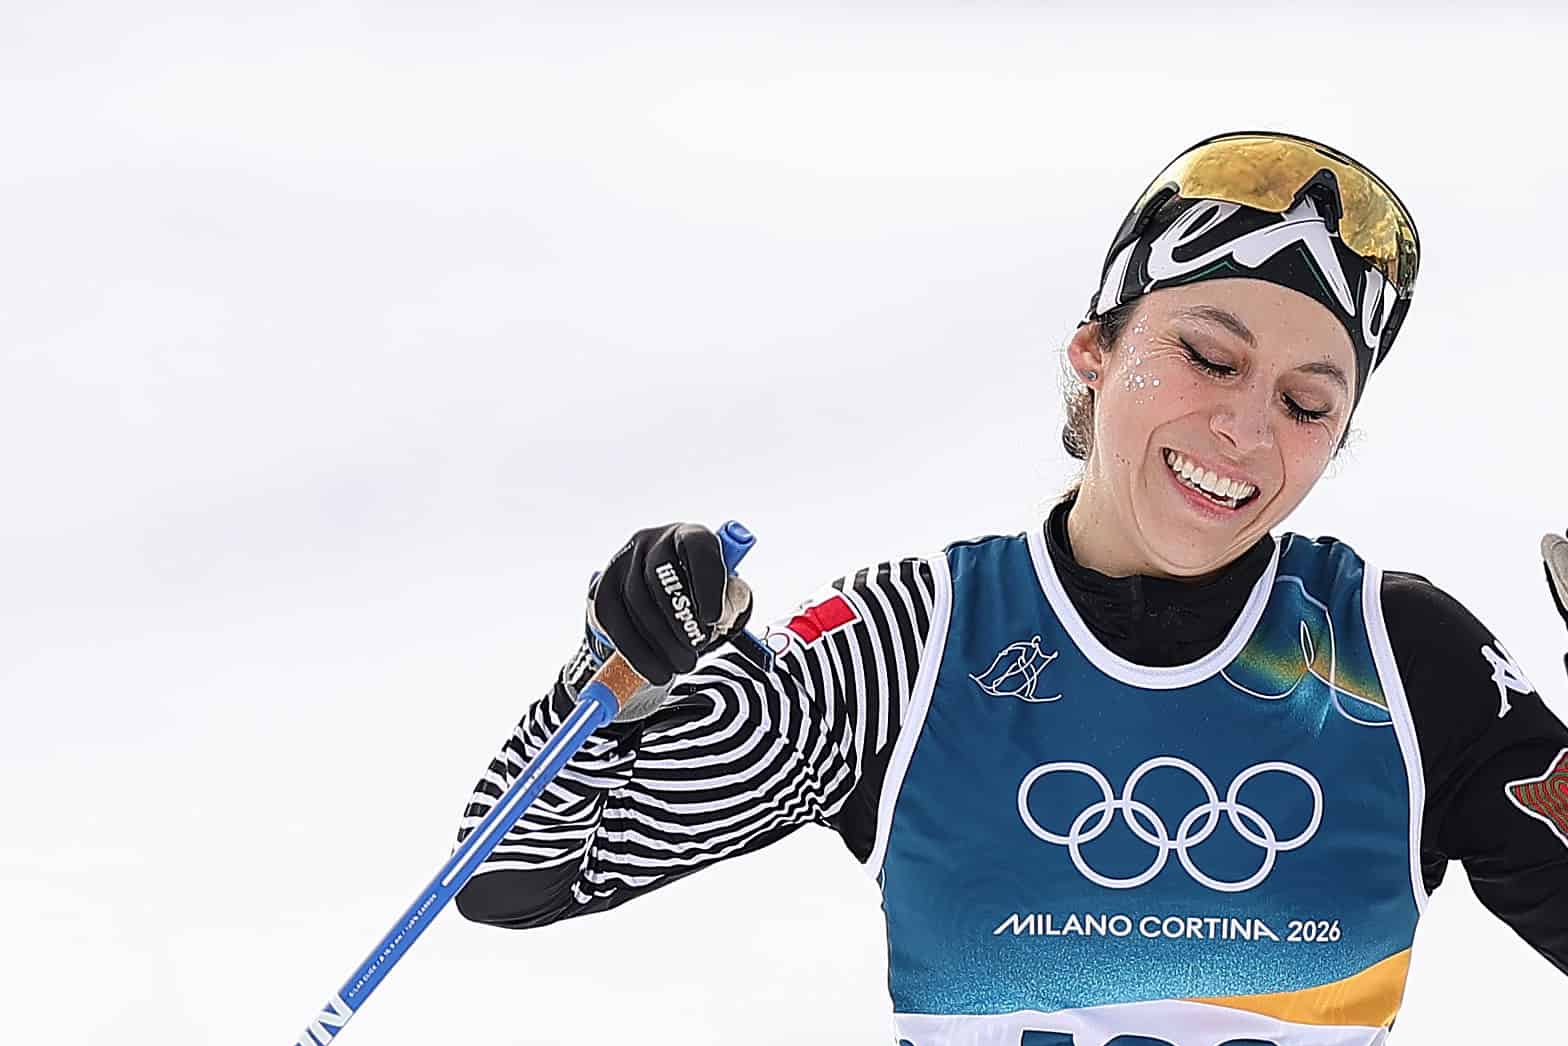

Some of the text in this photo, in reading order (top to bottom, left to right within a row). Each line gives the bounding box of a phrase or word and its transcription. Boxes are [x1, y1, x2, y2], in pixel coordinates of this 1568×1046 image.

[993, 912, 1342, 942] MILANO CORTINA 2026
